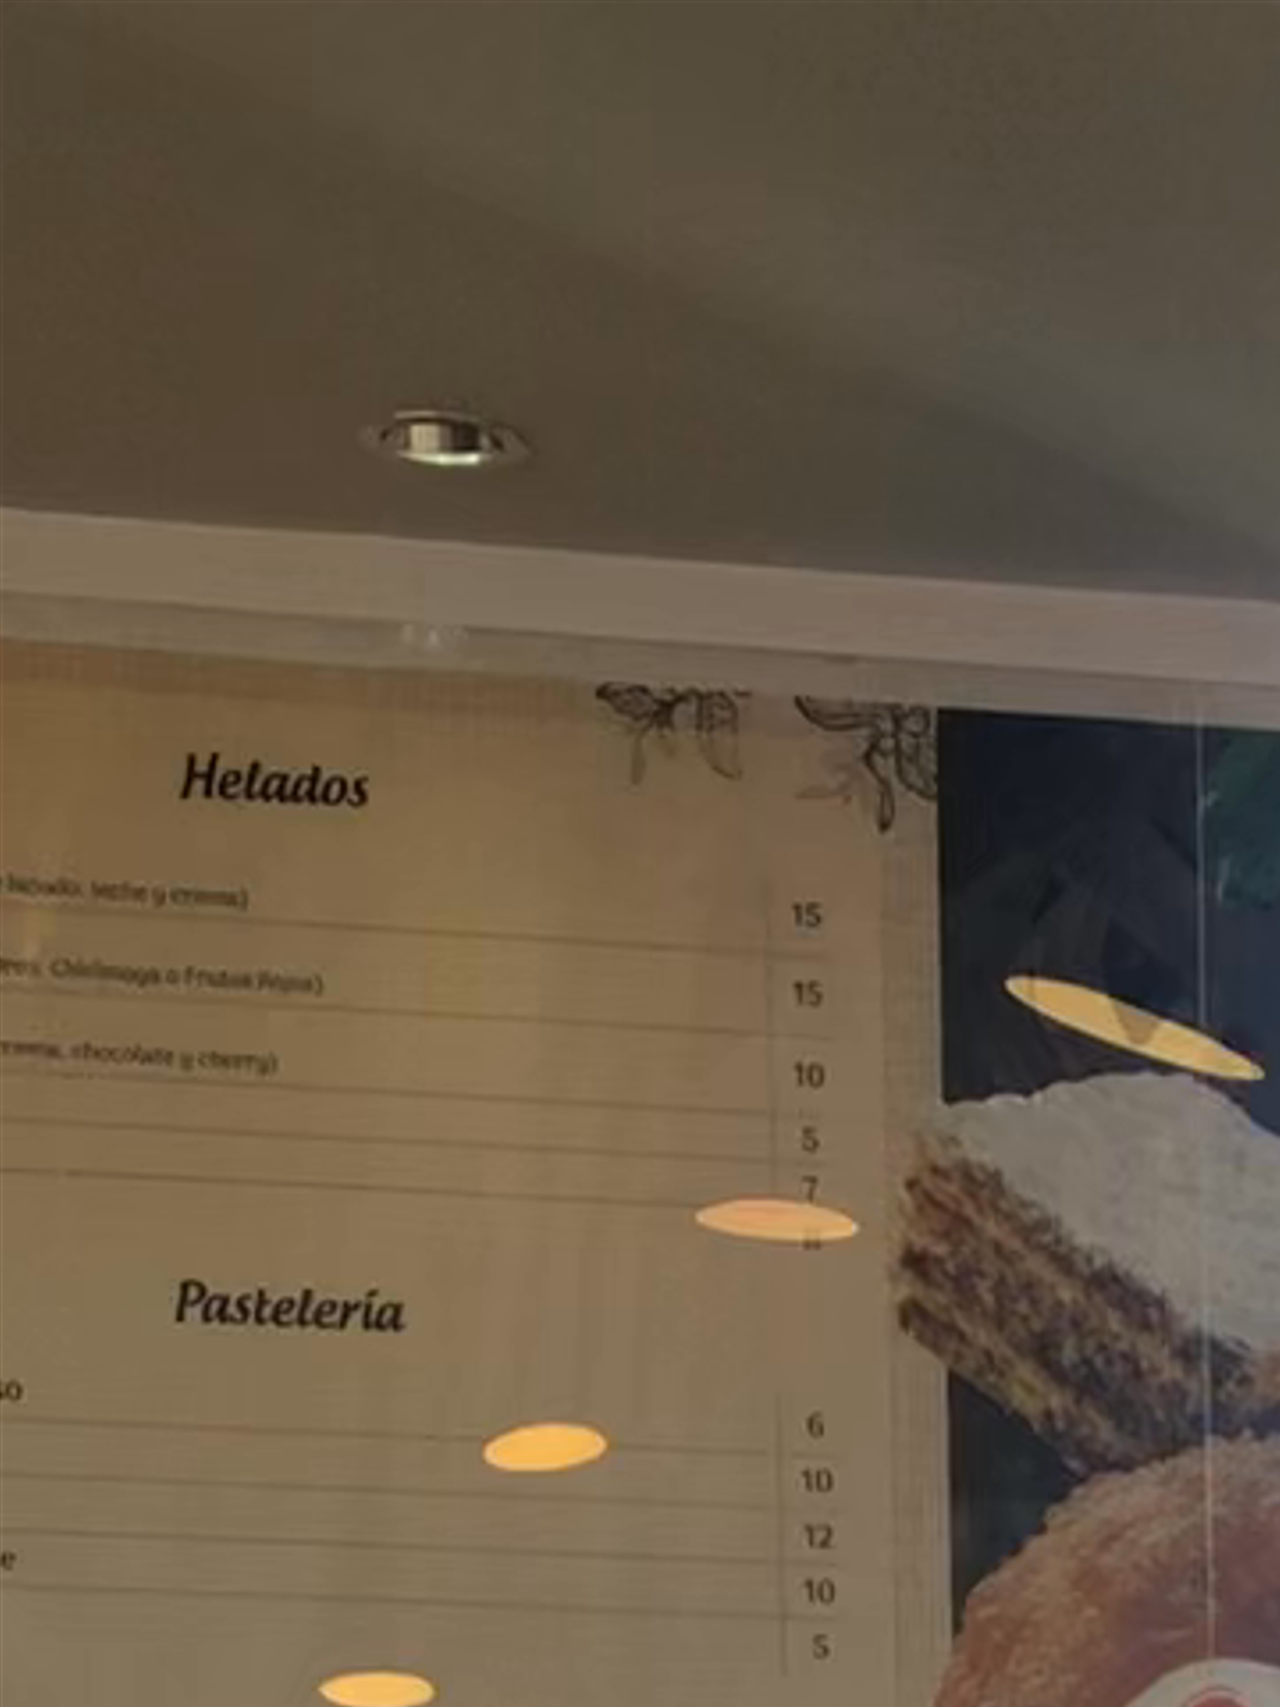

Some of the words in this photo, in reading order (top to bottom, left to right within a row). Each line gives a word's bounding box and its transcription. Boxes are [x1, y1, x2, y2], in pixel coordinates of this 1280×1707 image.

[180, 751, 370, 809] Helados
[792, 902, 822, 928] 15
[793, 980, 824, 1008] 15
[793, 1061, 826, 1089] 10
[801, 1125, 820, 1153] 5
[802, 1175, 818, 1201] 7
[176, 1279, 405, 1332] Pastelería
[805, 1410, 825, 1439] 6
[801, 1467, 834, 1493] 10
[804, 1522, 834, 1549] 12
[804, 1577, 836, 1605] 10
[812, 1633, 831, 1661] 5
